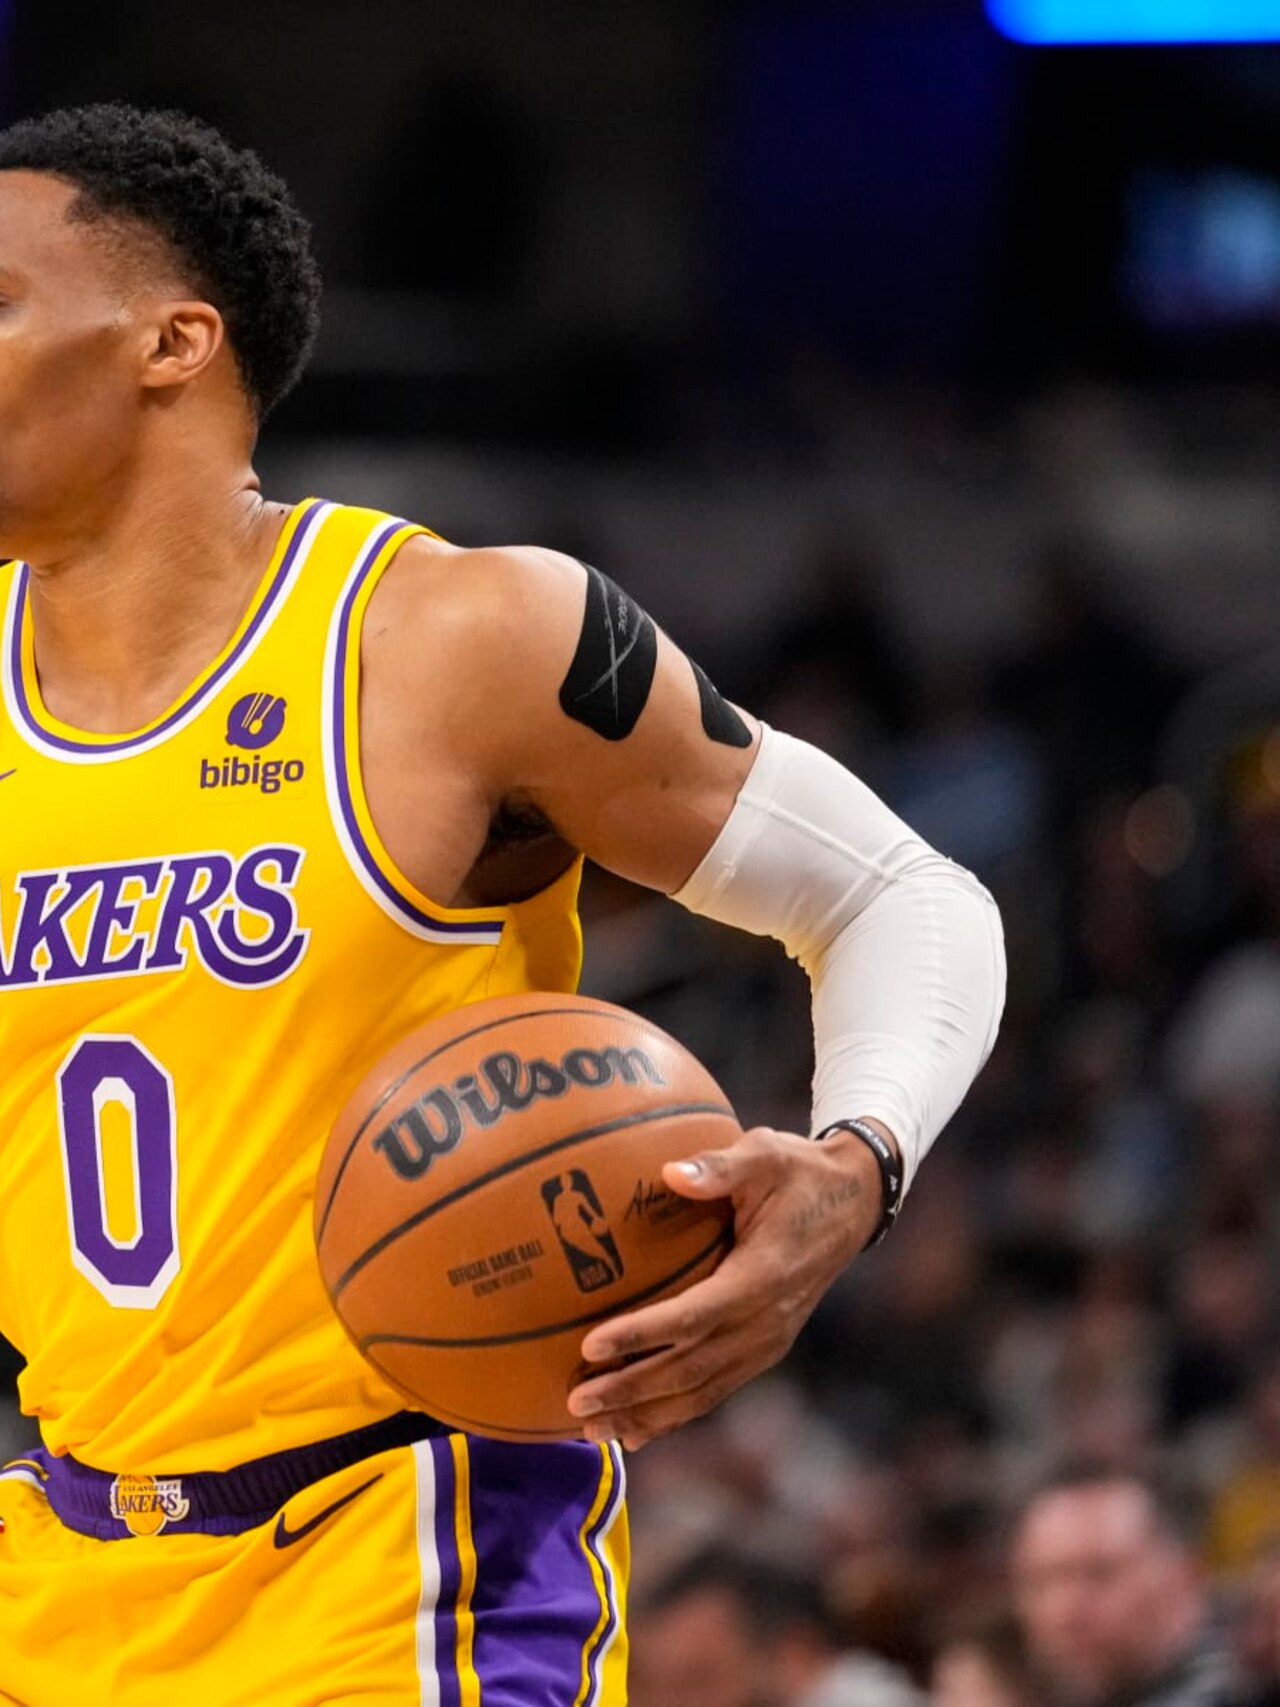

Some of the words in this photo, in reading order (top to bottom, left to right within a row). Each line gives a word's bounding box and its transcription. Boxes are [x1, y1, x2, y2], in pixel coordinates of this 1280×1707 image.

[199, 756, 305, 794] bibigo
[372, 1046, 667, 1182] Wilson
[54, 1032, 182, 1310] 0
[447, 1259, 490, 1288] OFFICIAL
[489, 1248, 518, 1272] GAME
[518, 1239, 545, 1262] BALL
[578, 1260, 610, 1289] NBA
[112, 1484, 187, 1519] LAKERS
